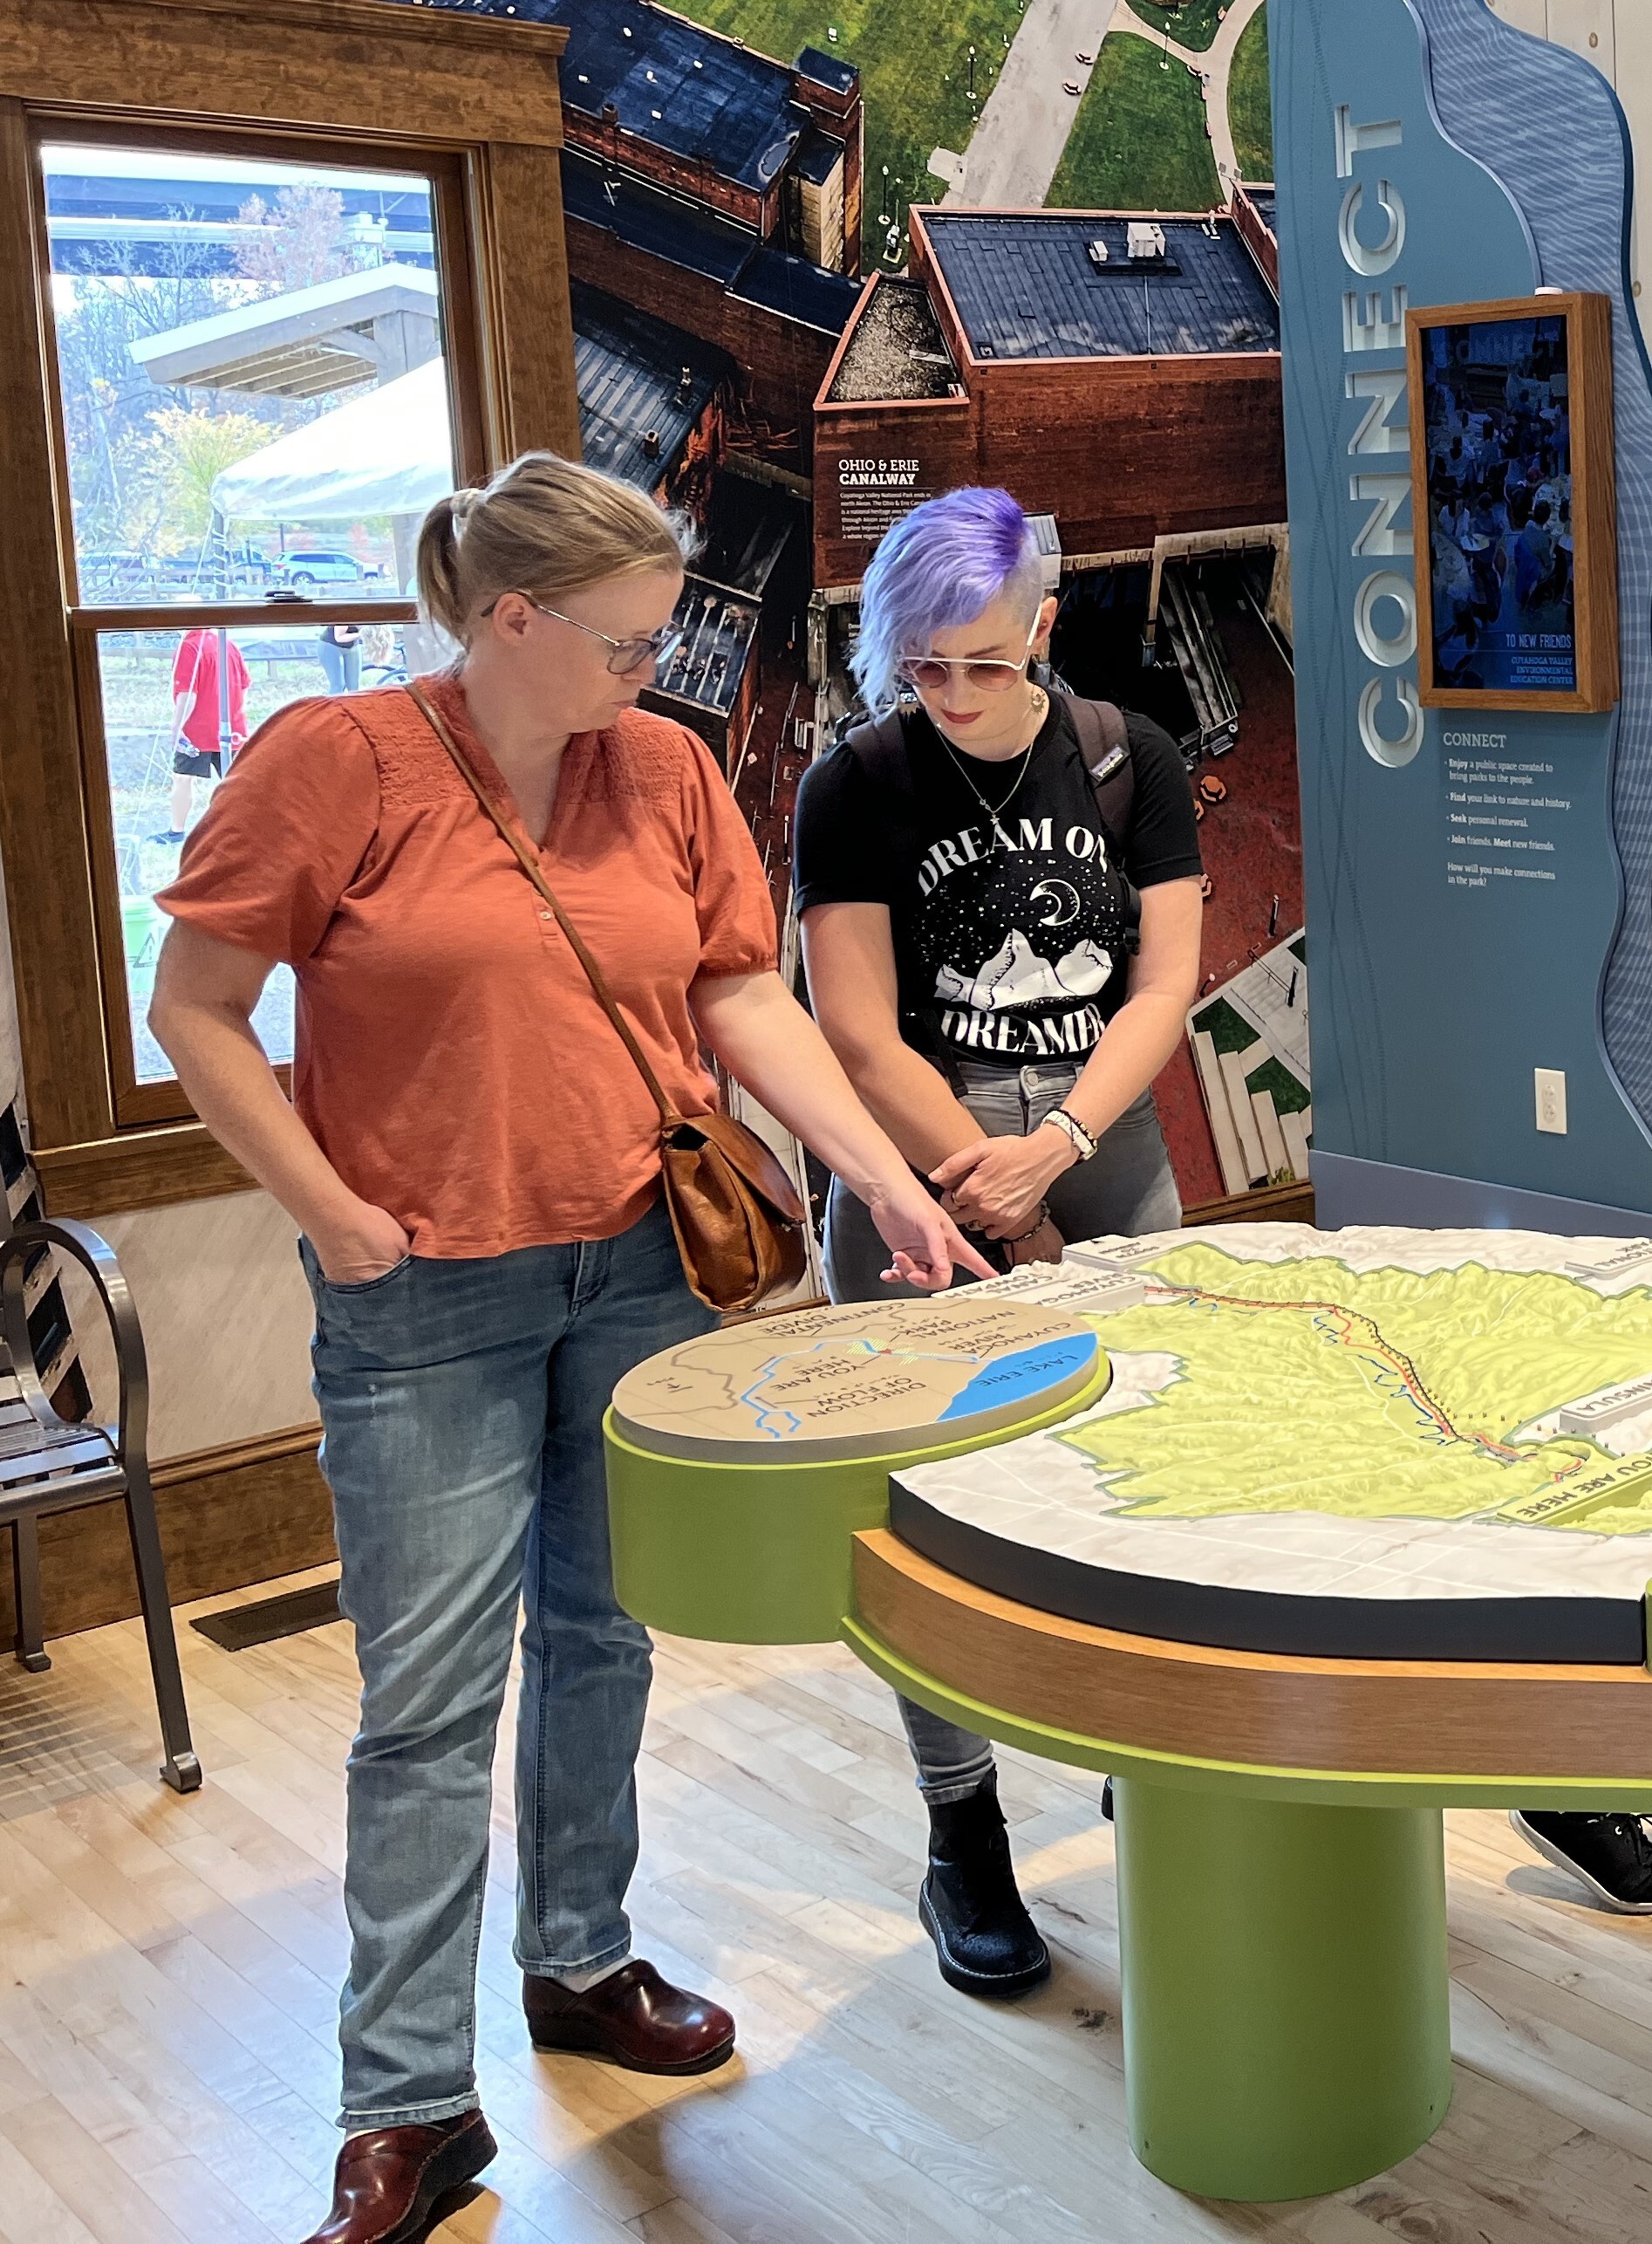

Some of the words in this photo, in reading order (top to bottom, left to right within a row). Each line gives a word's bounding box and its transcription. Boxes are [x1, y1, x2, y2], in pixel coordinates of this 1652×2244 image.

[1335, 104, 1424, 769] CONNECT
[838, 459, 876, 471] OHIO
[878, 459, 887, 471] &
[890, 459, 919, 471] ERIE
[839, 473, 916, 485] CANALWAY
[1505, 633, 1516, 647] TO
[1519, 633, 1537, 647] NEW
[1539, 633, 1572, 648] FRIENDS
[1511, 656, 1548, 665] CUYAHOGA
[1548, 657, 1573, 666] VALLEY
[1443, 732, 1507, 748] CONNECT
[1449, 758, 1468, 770] Enjoy
[1475, 759, 1498, 771] public
[1498, 763, 1518, 772] space
[1545, 763, 1553, 773] to
[1449, 770, 1468, 783] bring
[1469, 772, 1488, 783] parks
[1488, 773, 1496, 782] to
[1497, 773, 1509, 783] the
[1509, 775, 1534, 786] people.
[1450, 791, 1466, 802] Find
[1466, 795, 1483, 805] your
[1483, 793, 1498, 804] link
[1498, 795, 1506, 804] to
[1506, 796, 1530, 806] nature
[1530, 797, 1545, 807] and
[1545, 797, 1572, 811] history.
[1451, 813, 1467, 823] Seek
[1468, 816, 1498, 826] personal
[1498, 817, 1528, 827] renewal.
[1451, 834, 1466, 844] Join
[1492, 838, 1512, 848] Meet
[1512, 840, 1528, 849] new
[918, 818, 1054, 897] DREAM
[1447, 862, 1464, 872] How
[1464, 864, 1478, 873] will
[1478, 866, 1493, 876] you
[1493, 865, 1513, 876] make
[1513, 869, 1556, 880] connections
[1447, 875, 1456, 884] in
[1456, 875, 1468, 885] the
[1468, 877, 1487, 887] park?
[759, 1314, 828, 1334] DIVIDE
[769, 1303, 905, 1337] CONTINENTAL
[898, 1319, 952, 1336] PARK
[911, 1310, 1016, 1339] NATIONAL
[947, 1333, 1006, 1350] RIVER
[961, 1322, 1071, 1354] CUYAHOGA
[795, 1358, 851, 1377] HERE
[817, 1365, 866, 1379] YOU
[1023, 1355, 1079, 1374] LAKE
[769, 1376, 811, 1392] ARE
[884, 1378, 912, 1389] OF
[973, 1371, 1024, 1387] ERIE
[807, 1382, 927, 1418] DIRECTION
[817, 1386, 881, 1407] FLOW
[1573, 1473, 1616, 1494] ARE
[1516, 1490, 1578, 1518] HERE
